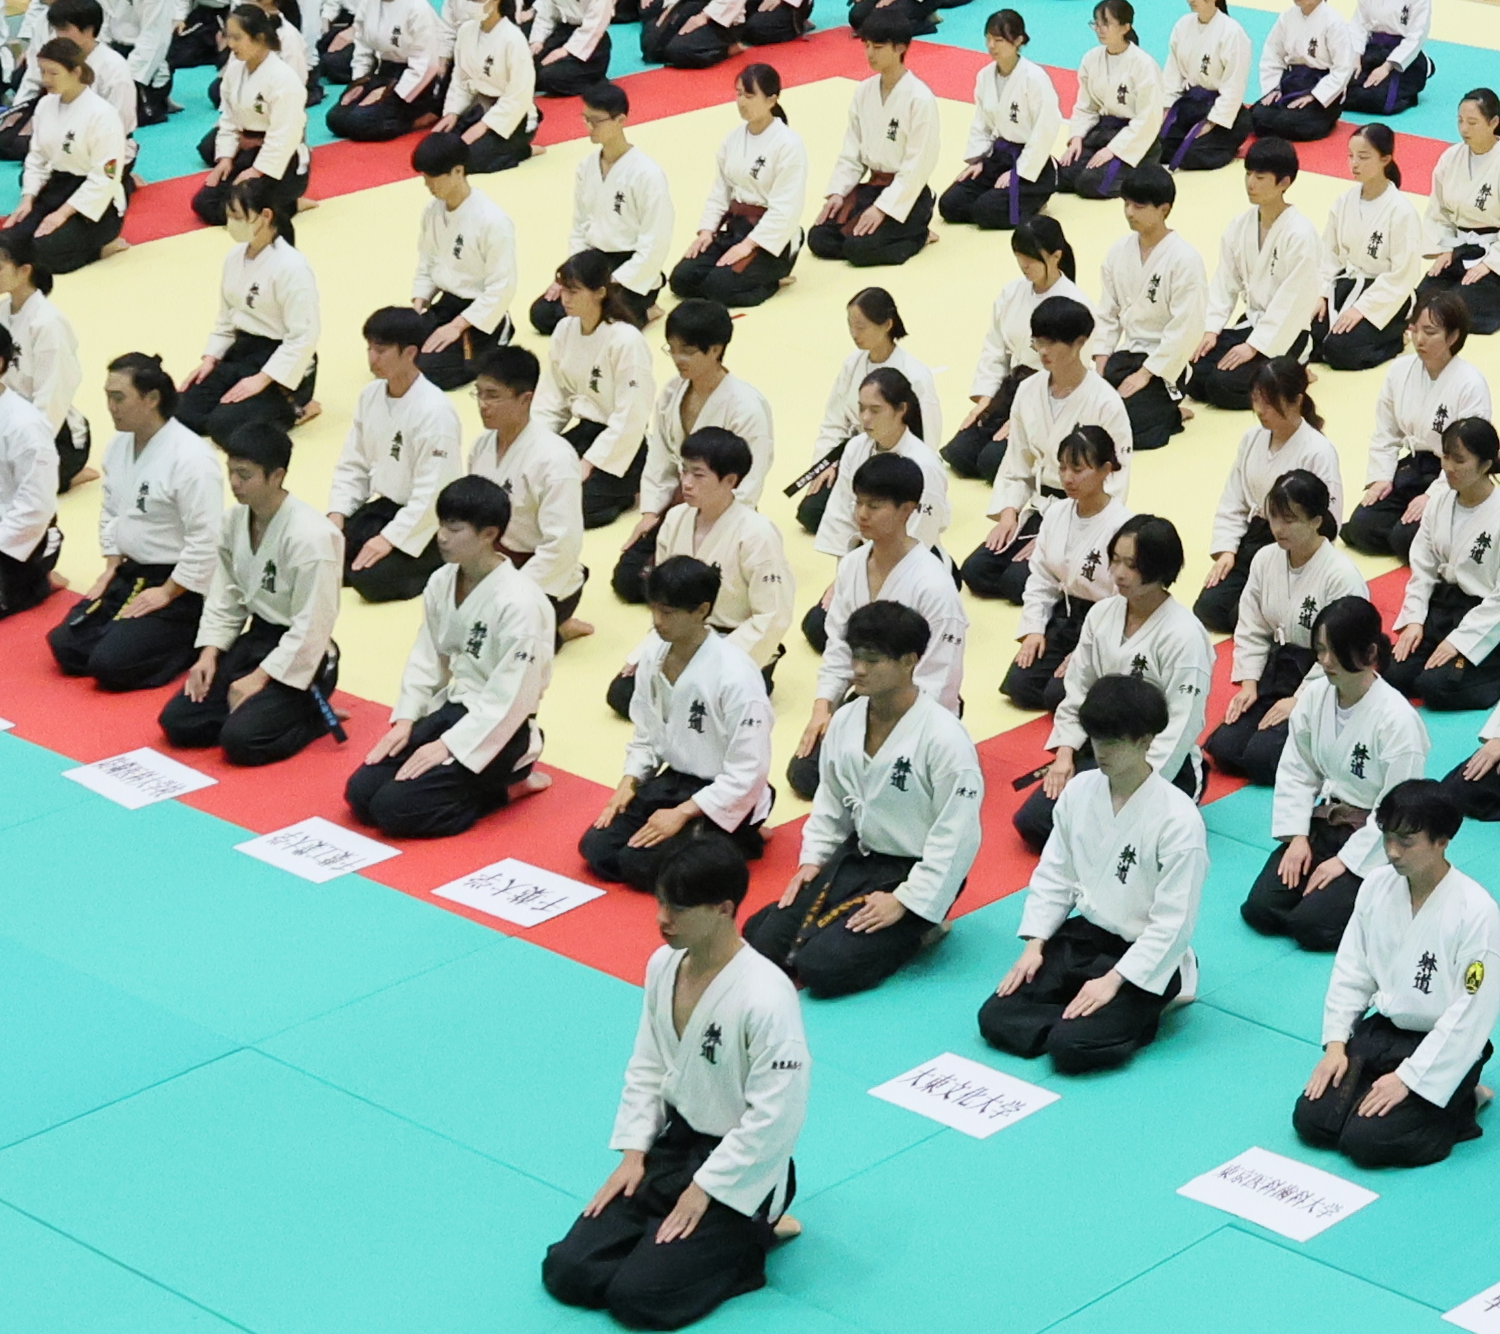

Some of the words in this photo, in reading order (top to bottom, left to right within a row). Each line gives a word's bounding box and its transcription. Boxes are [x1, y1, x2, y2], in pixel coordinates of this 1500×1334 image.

[465, 621, 487, 659] 躰道
[891, 756, 912, 792] 躰道
[1350, 742, 1370, 779] 躰道
[266, 830, 368, 872] 千葉工業大学
[1115, 844, 1136, 884] 躰道
[463, 869, 569, 914] 千葉大学
[1413, 951, 1437, 994] 躰道
[700, 1023, 722, 1065] 躰道
[899, 1066, 1027, 1120] 大東文化大学
[1216, 1164, 1345, 1220] 東京医科歯科大学
